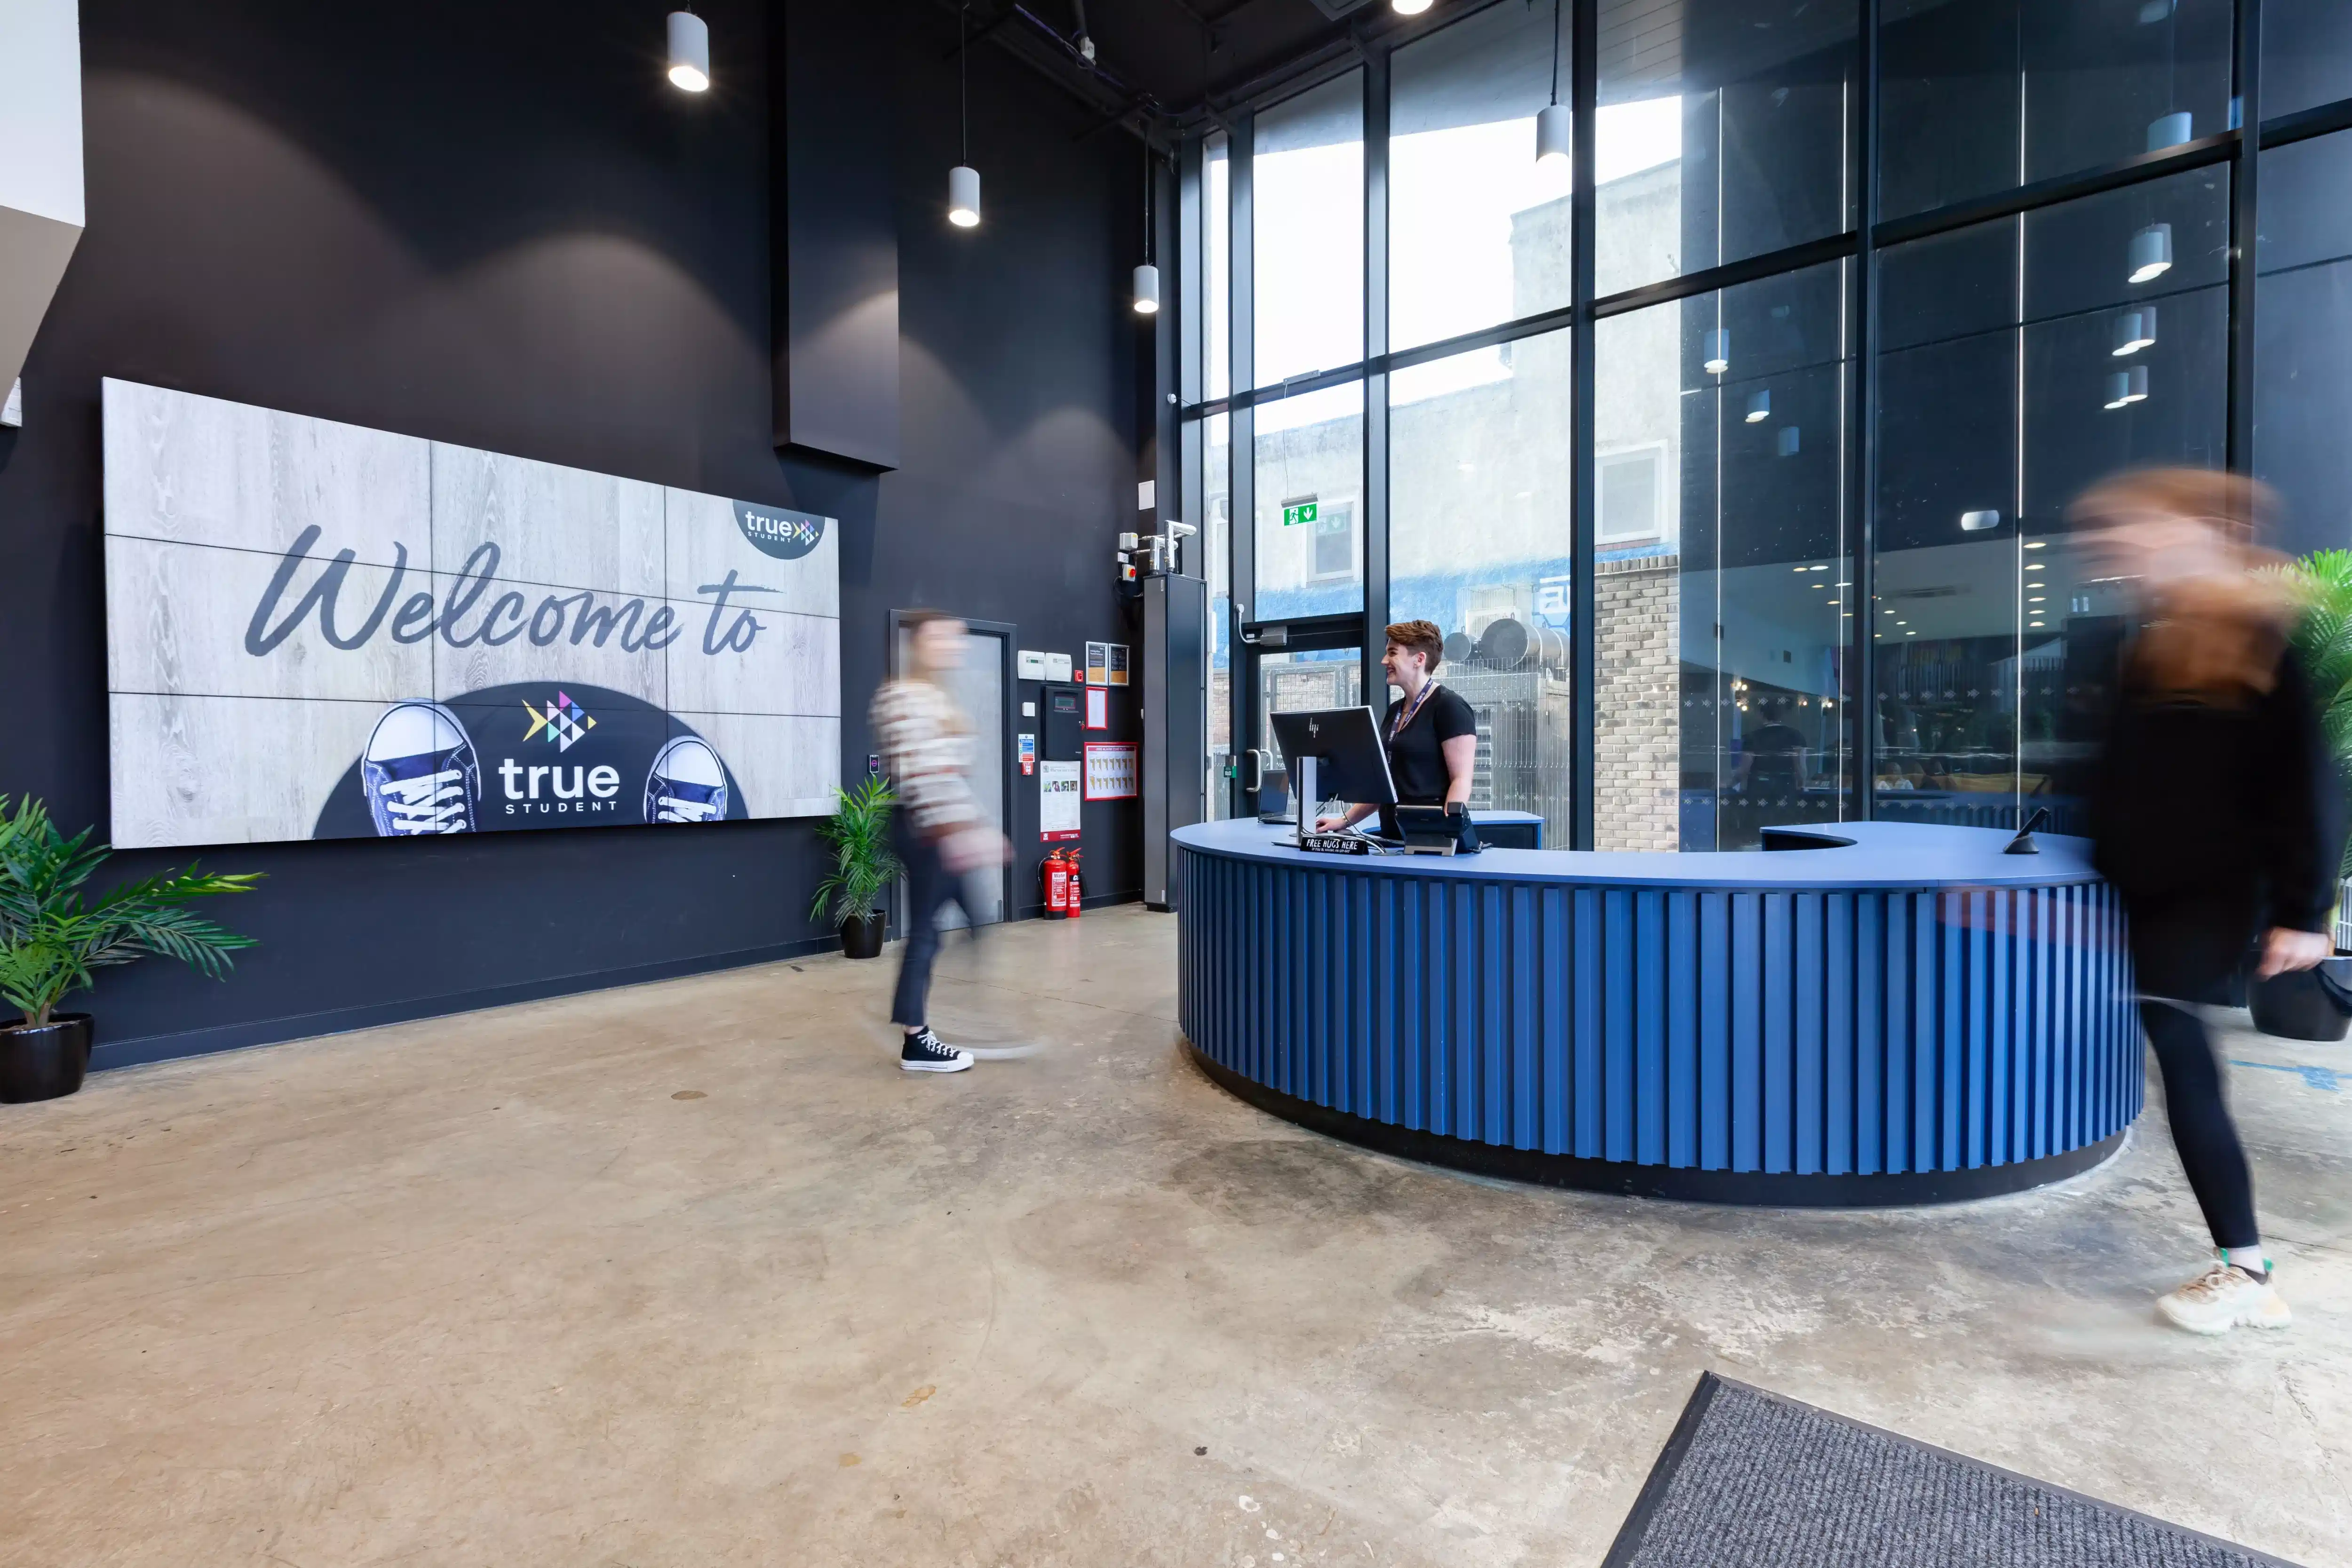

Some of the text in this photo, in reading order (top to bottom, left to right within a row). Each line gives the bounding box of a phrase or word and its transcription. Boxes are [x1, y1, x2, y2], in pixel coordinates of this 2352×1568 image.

[745, 511, 792, 536] true
[747, 531, 791, 543] STUDENT
[245, 524, 786, 657] Welcome to
[1309, 717, 1319, 738] hp
[499, 758, 620, 800] true
[506, 801, 616, 814] STUDENT
[1307, 839, 1358, 850] FREE HUGS HERE
